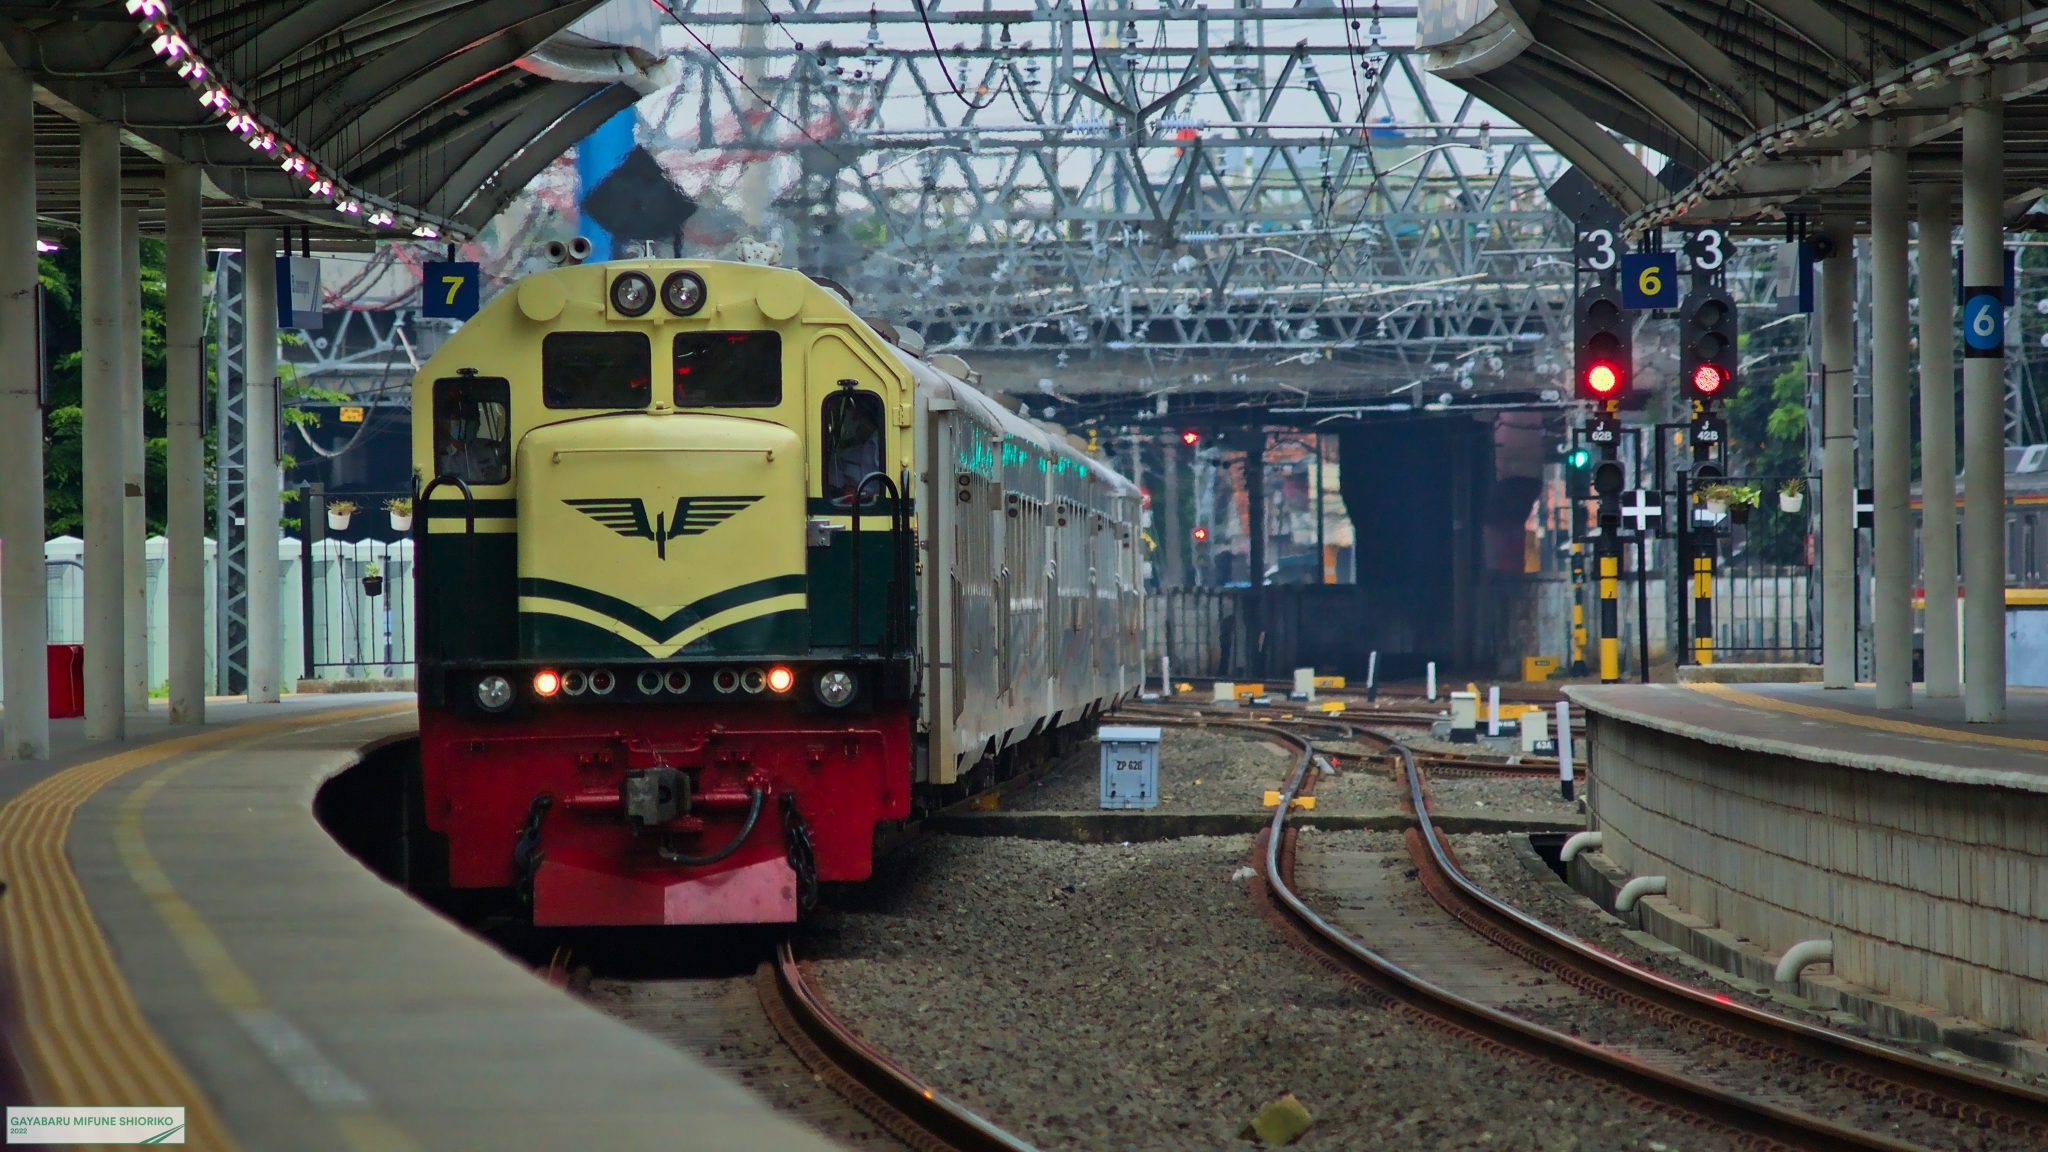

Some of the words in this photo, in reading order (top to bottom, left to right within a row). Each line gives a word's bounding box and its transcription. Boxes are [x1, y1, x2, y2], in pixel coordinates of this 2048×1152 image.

[1588, 229, 1616, 270] 3
[1696, 229, 1723, 270] 3
[441, 276, 465, 305] 7
[1638, 266, 1662, 296] 6
[1973, 304, 1995, 336] 6
[1596, 421, 1604, 431] J
[1702, 420, 1710, 430] J
[1591, 431, 1613, 441] 62B
[1697, 431, 1719, 441] 42B
[1116, 760, 1127, 771] ZP
